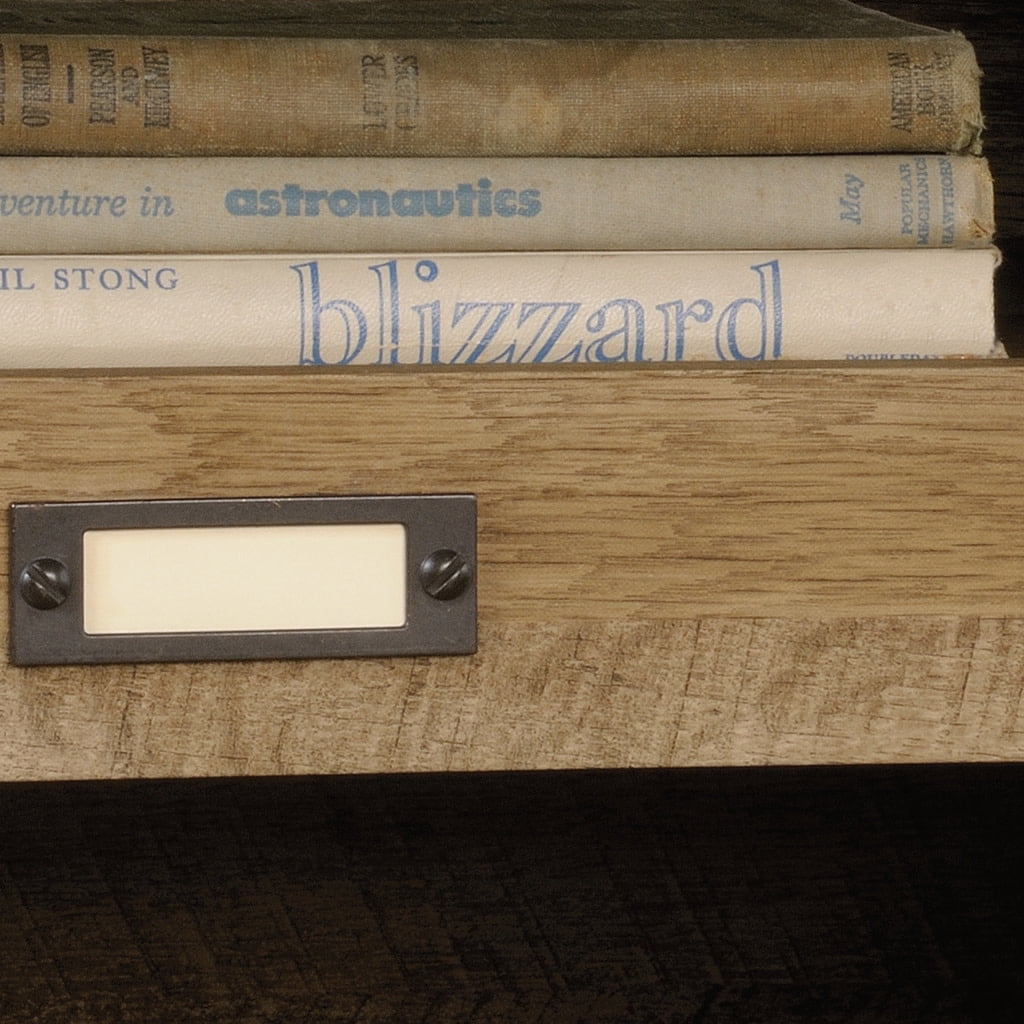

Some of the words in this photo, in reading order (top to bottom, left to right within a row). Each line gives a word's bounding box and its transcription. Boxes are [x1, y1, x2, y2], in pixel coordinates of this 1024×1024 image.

[88, 48, 117, 125] PEARSON
[121, 66, 139, 108] AND
[888, 52, 913, 133] AMERICAN
[139, 186, 174, 217] in
[224, 179, 542, 218] astronautics
[839, 173, 865, 225] May
[900, 163, 914, 235] POPULAR
[914, 157, 931, 245] MECHANICS
[54, 268, 179, 291] STONG
[289, 259, 783, 366] blizzard
